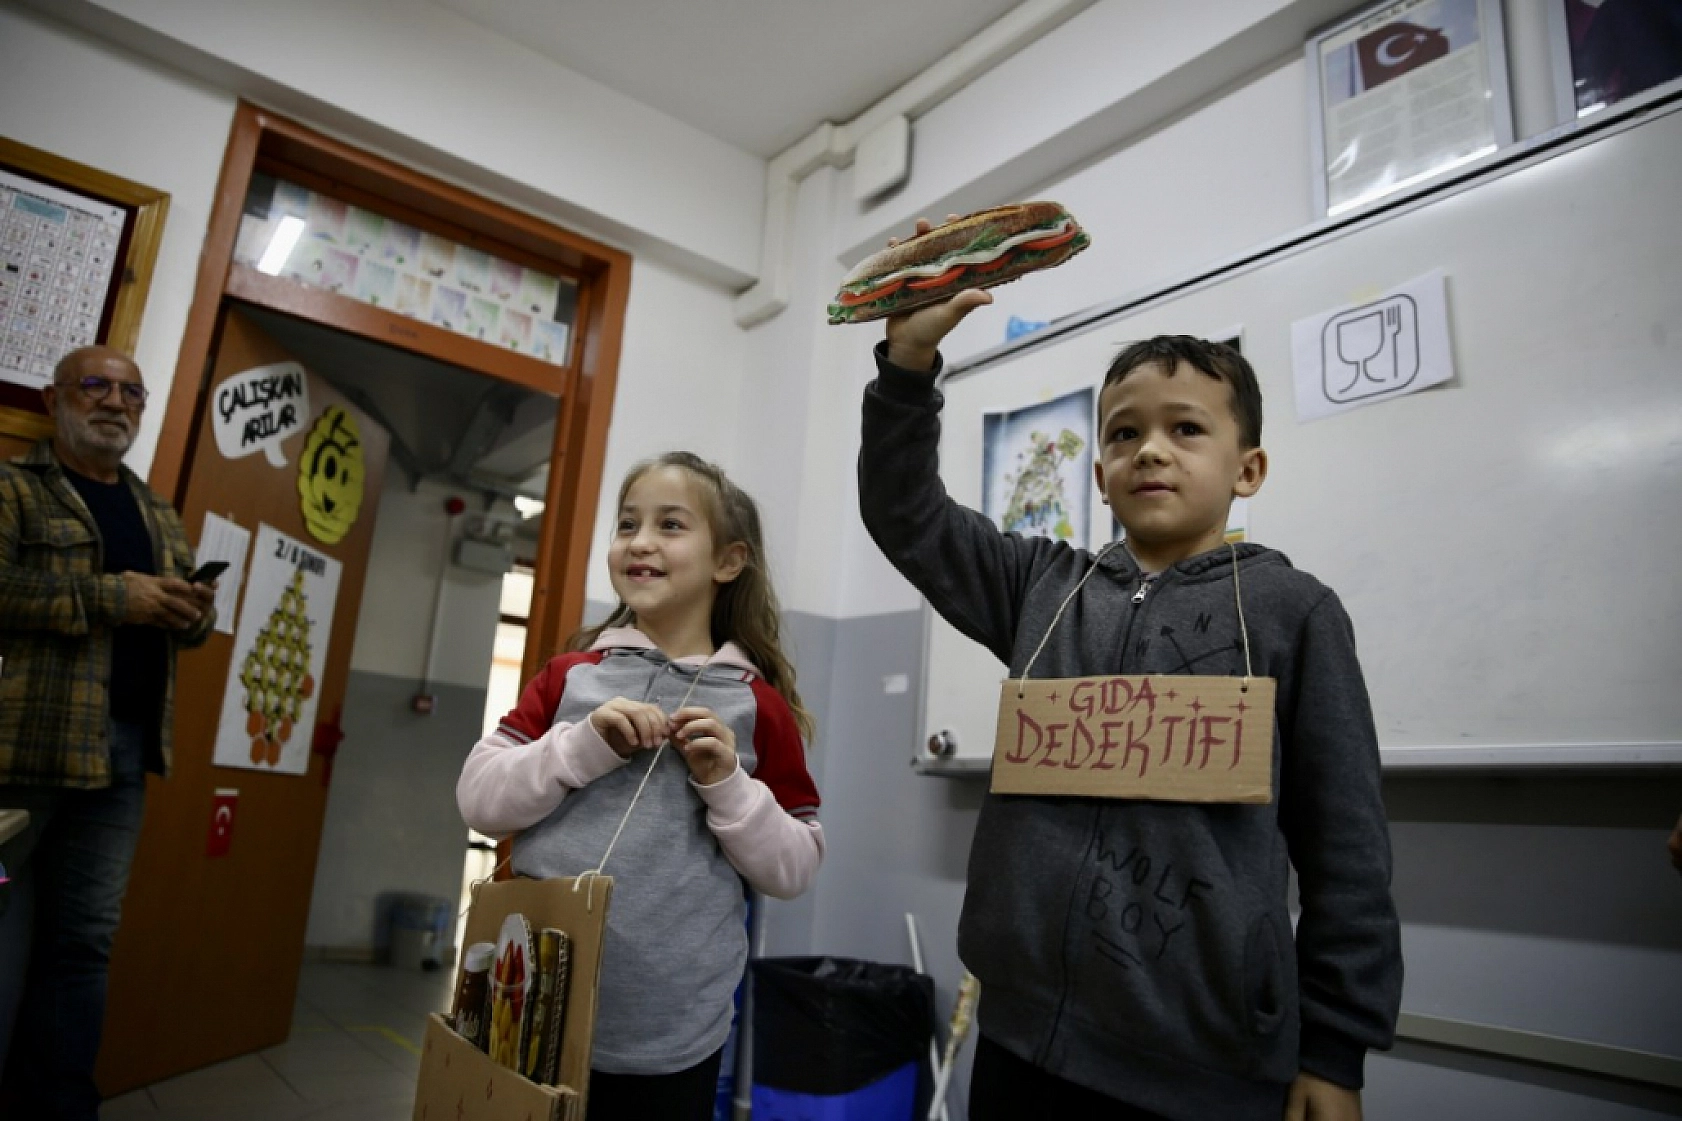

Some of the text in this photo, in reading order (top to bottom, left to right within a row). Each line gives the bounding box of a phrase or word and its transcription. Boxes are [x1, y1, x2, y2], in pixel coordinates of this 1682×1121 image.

[219, 373, 302, 424] ÇALIŞKAN
[241, 404, 297, 447] ARILAR
[1068, 677, 1157, 720] GIDA
[1097, 830, 1214, 911] WOLF
[1086, 876, 1186, 960] BOY
